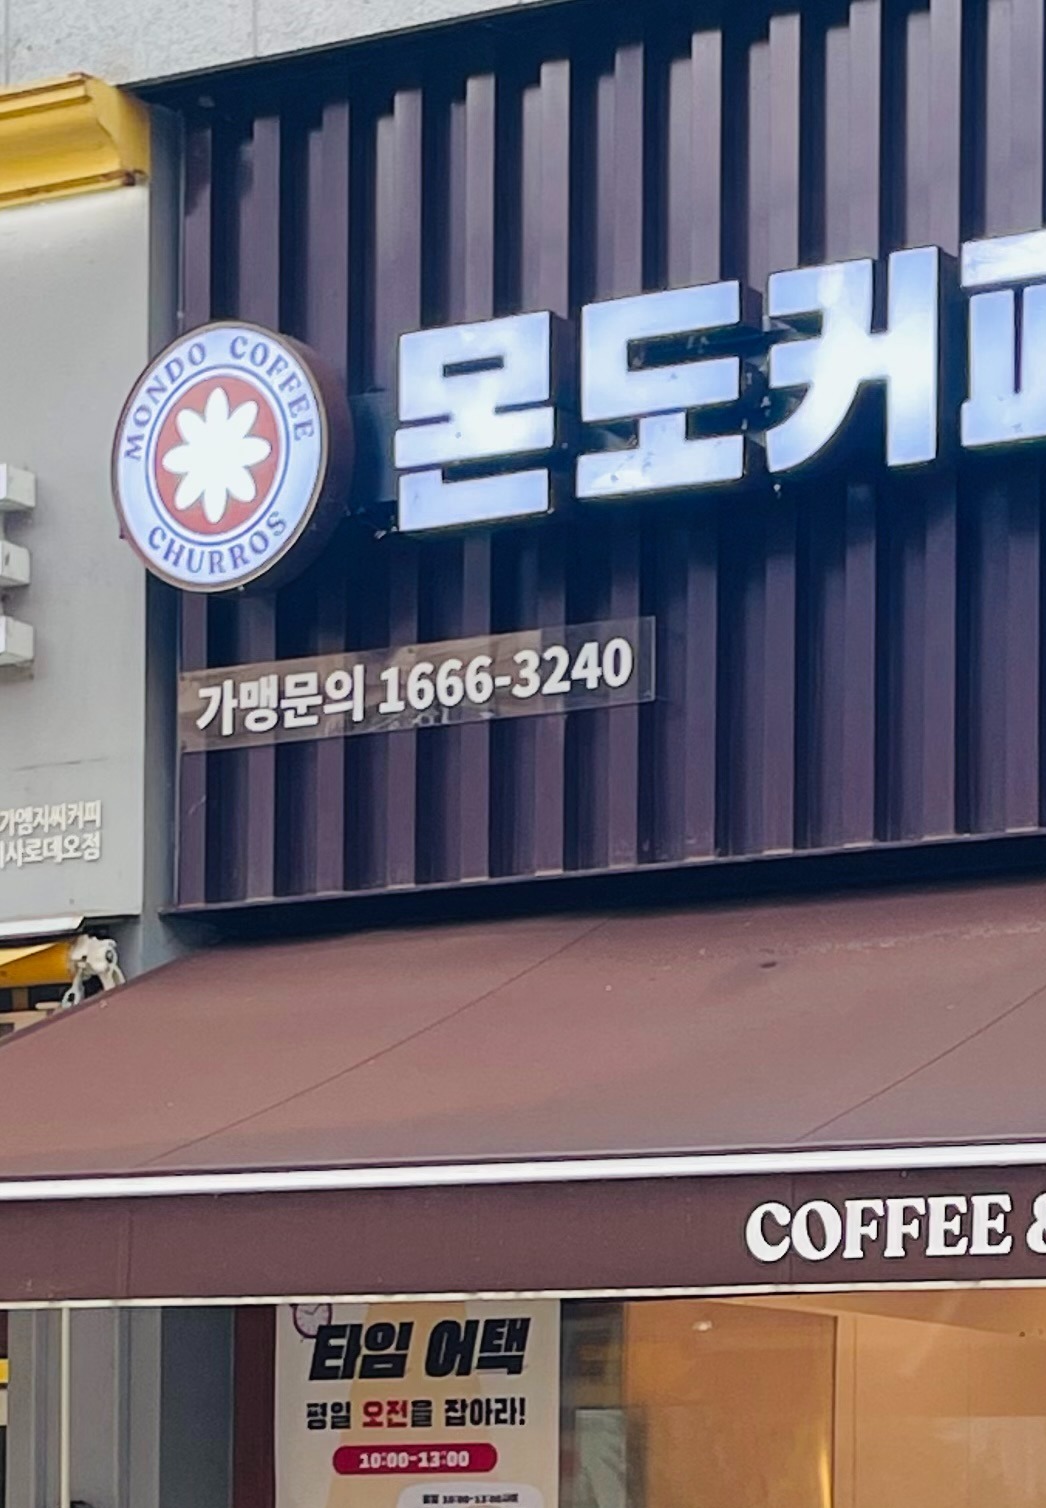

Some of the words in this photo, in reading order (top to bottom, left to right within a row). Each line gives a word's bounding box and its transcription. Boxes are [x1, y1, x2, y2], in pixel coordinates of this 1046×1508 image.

[123, 341, 207, 462] MONDO
[229, 335, 315, 442] COFFEE
[149, 511, 288, 575] CHURROS
[196, 664, 364, 737] 가맹문의
[378, 637, 634, 715] 1666-3240
[0, 831, 101, 868] 사로데오점
[745, 1194, 1014, 1262] COFFEE
[308, 1321, 414, 1381] 타임
[424, 1317, 532, 1378] 어택
[306, 1401, 351, 1431] 평일
[362, 1399, 433, 1430] 오전을
[444, 1397, 526, 1427] 잡아라!
[358, 1450, 470, 1470] 10:00-13:00
